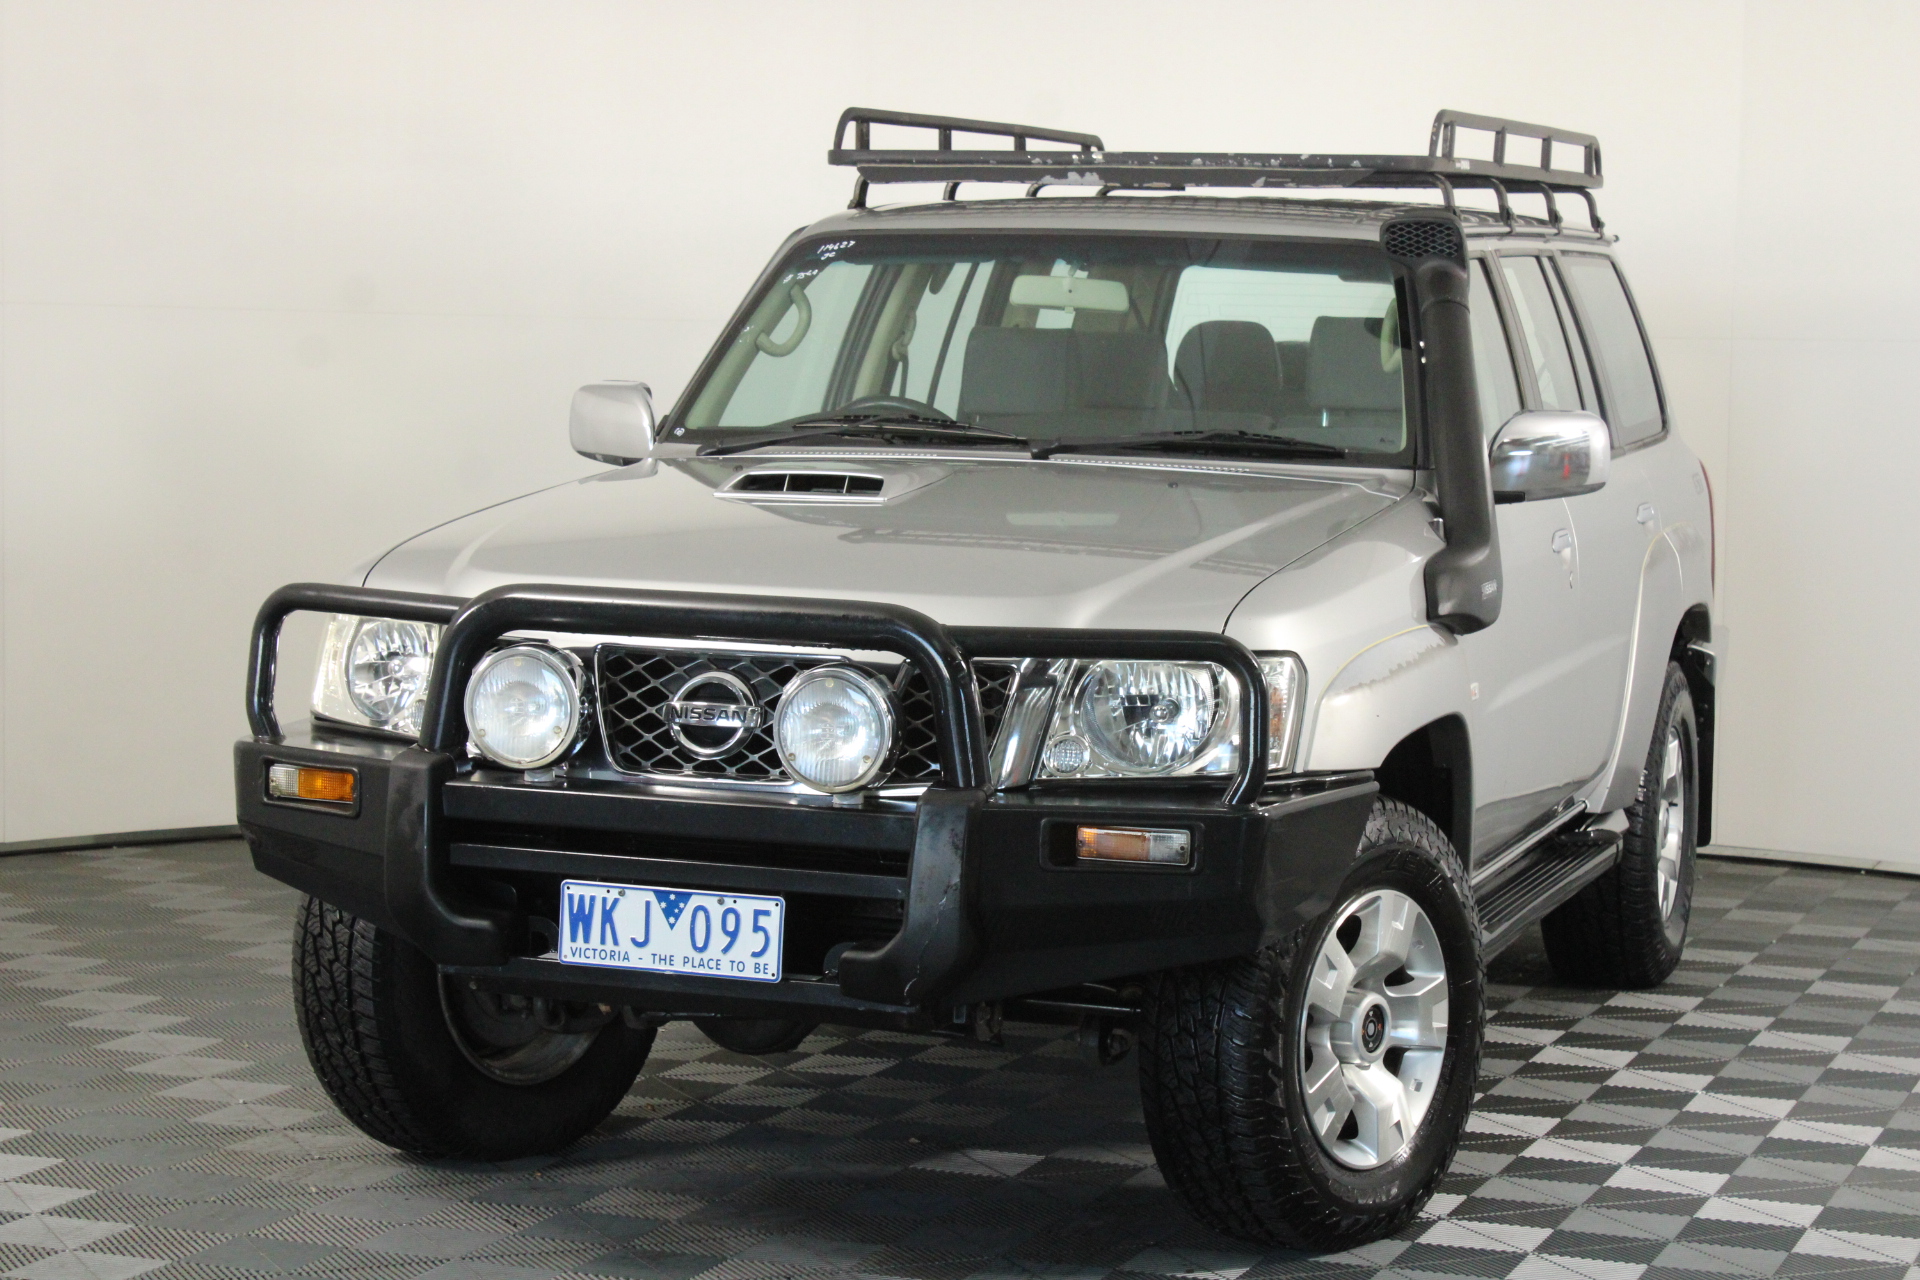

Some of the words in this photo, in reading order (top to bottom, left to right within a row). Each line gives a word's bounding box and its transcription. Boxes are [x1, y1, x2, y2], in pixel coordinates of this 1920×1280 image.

[670, 706, 747, 722] NISSAN
[567, 892, 651, 948] WKJ
[689, 904, 773, 958] 095
[570, 946, 631, 963] VICTORIA
[651, 953, 674, 967] THE
[683, 956, 722, 971] PLACE
[729, 960, 746, 973] TO
[754, 962, 770, 975] BE
